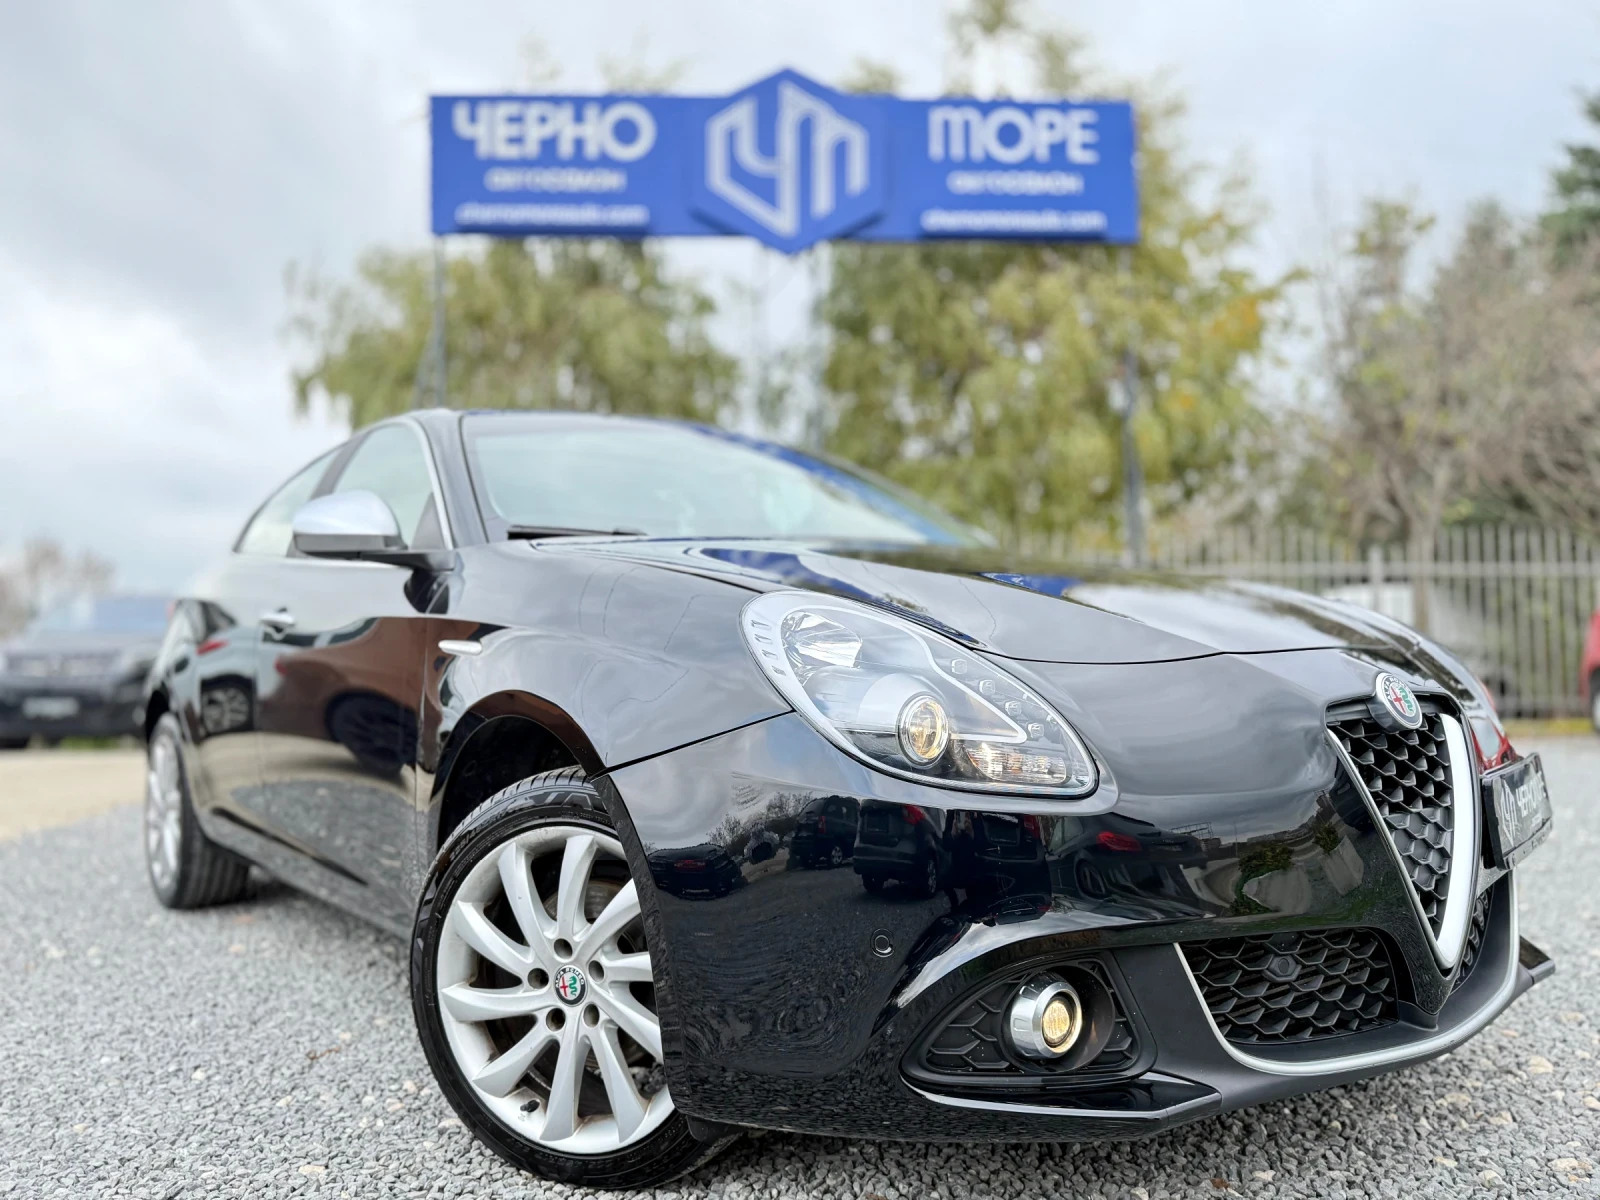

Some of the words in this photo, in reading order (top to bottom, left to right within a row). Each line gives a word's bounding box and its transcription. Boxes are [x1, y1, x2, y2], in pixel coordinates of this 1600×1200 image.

[452, 100, 657, 162] ЧЕРНО
[928, 105, 1100, 165] МОРЕ
[566, 967, 584, 985] ROMEO
